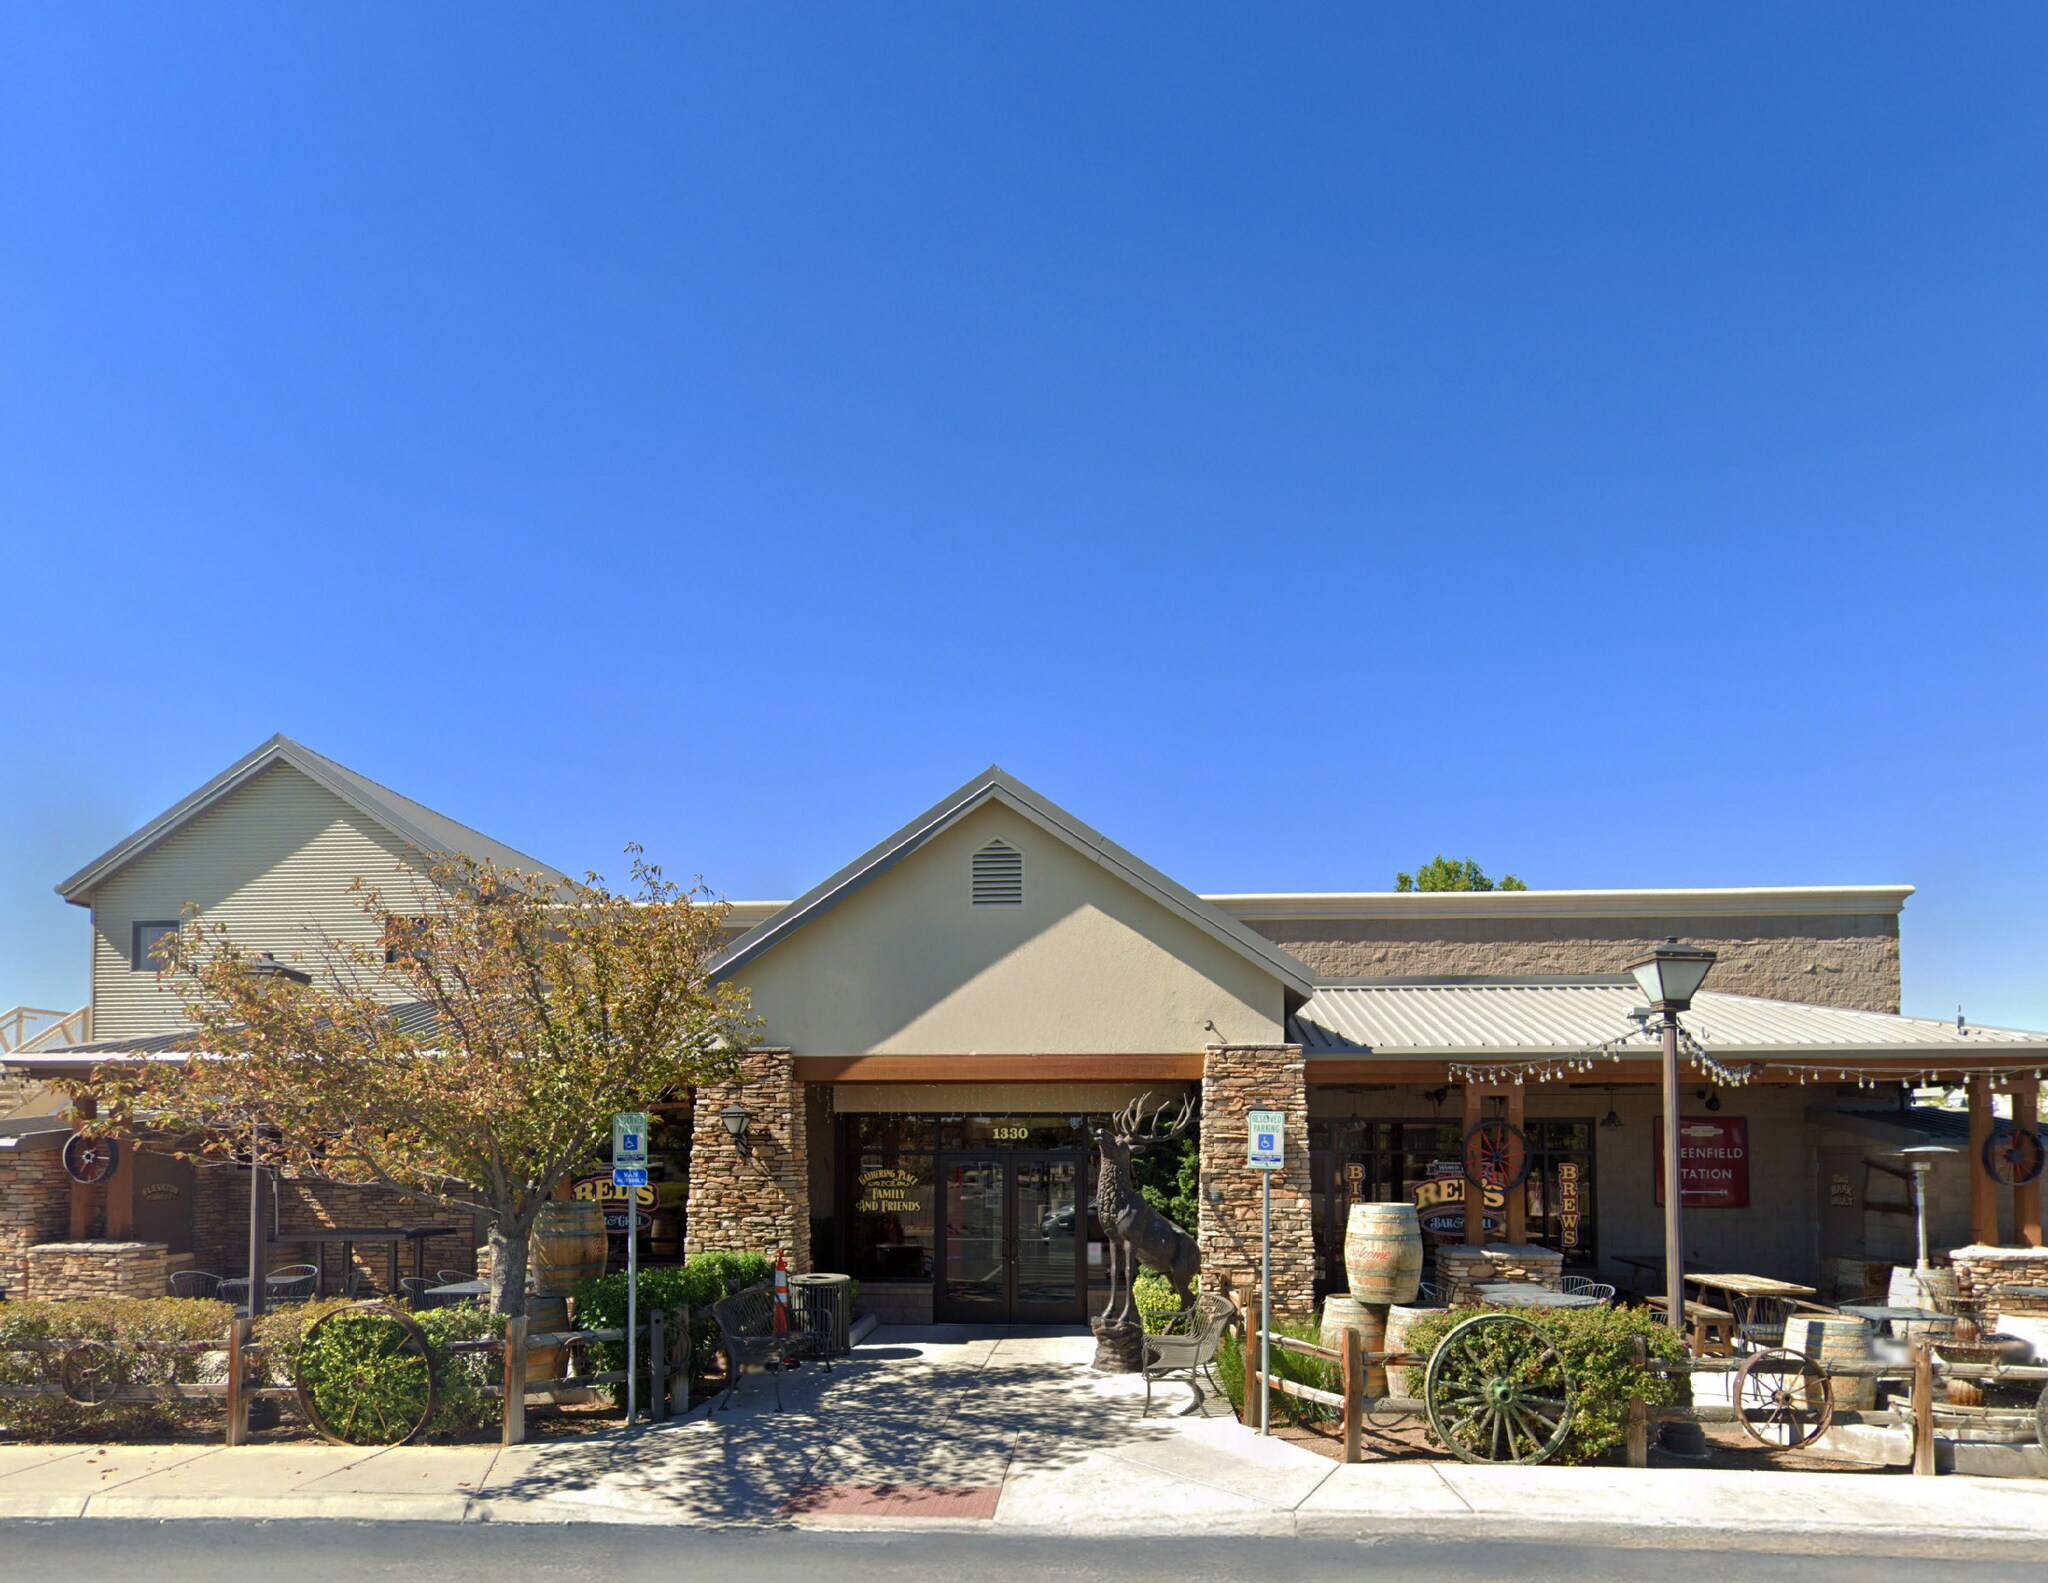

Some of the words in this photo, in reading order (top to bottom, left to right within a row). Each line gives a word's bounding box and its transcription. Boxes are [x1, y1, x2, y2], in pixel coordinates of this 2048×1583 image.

[1252, 1115, 1281, 1123] RESERVED
[993, 1128, 1028, 1139] 1330
[1253, 1124, 1280, 1133] PARKING
[1663, 1148, 1743, 1159] EENFIELD
[859, 1169, 896, 1185] GATHERING
[897, 1169, 919, 1185] PLACE
[1680, 1169, 1732, 1179] TATION
[1348, 1165, 1363, 1204] BIT
[574, 1179, 654, 1205] REDS
[873, 1188, 905, 1200] FAMILY
[856, 1200, 878, 1212] AND
[882, 1200, 921, 1213] FRIENDS
[1561, 1165, 1578, 1244] BREWS
